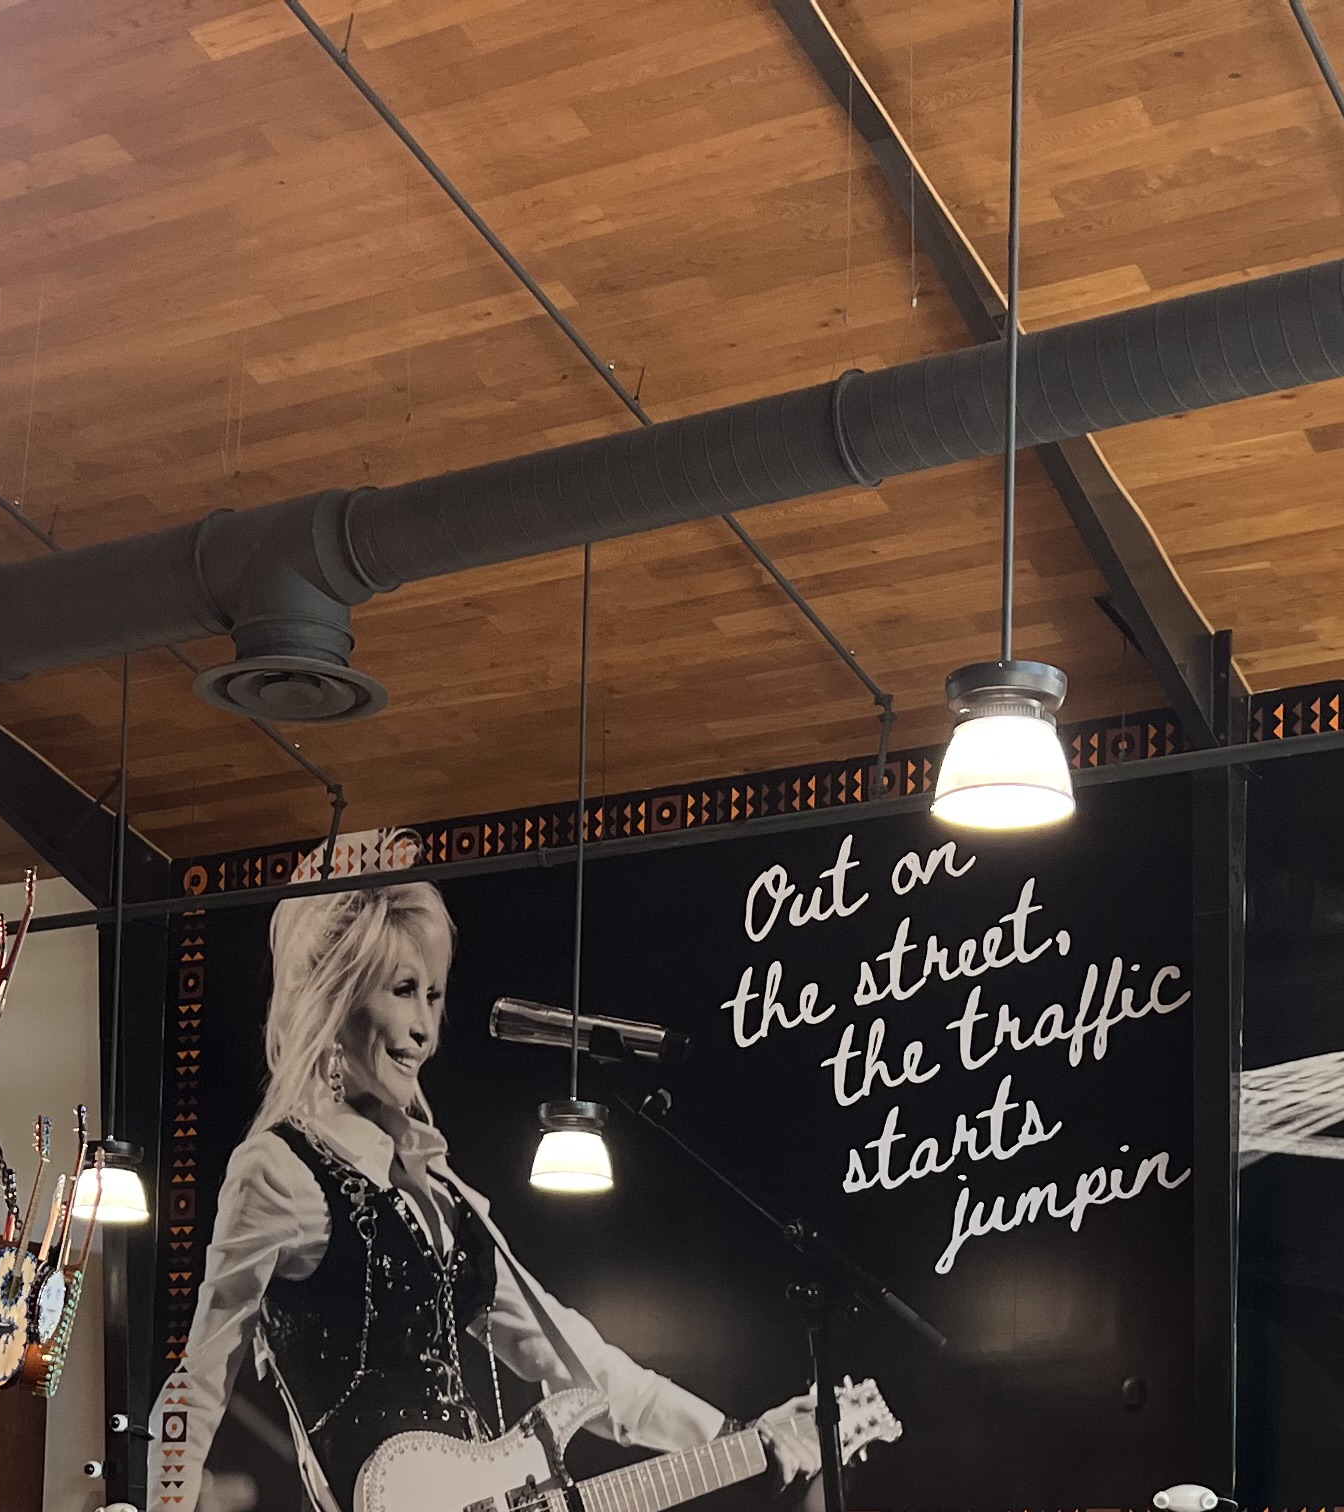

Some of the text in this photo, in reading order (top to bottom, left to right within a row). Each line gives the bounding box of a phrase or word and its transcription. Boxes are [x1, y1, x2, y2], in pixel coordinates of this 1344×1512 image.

[745, 834, 976, 941] Out on
[721, 878, 1071, 1047] the street,
[821, 956, 1191, 1106] the traffic
[842, 1075, 1062, 1193] starts
[935, 1145, 1191, 1275] jumpin
